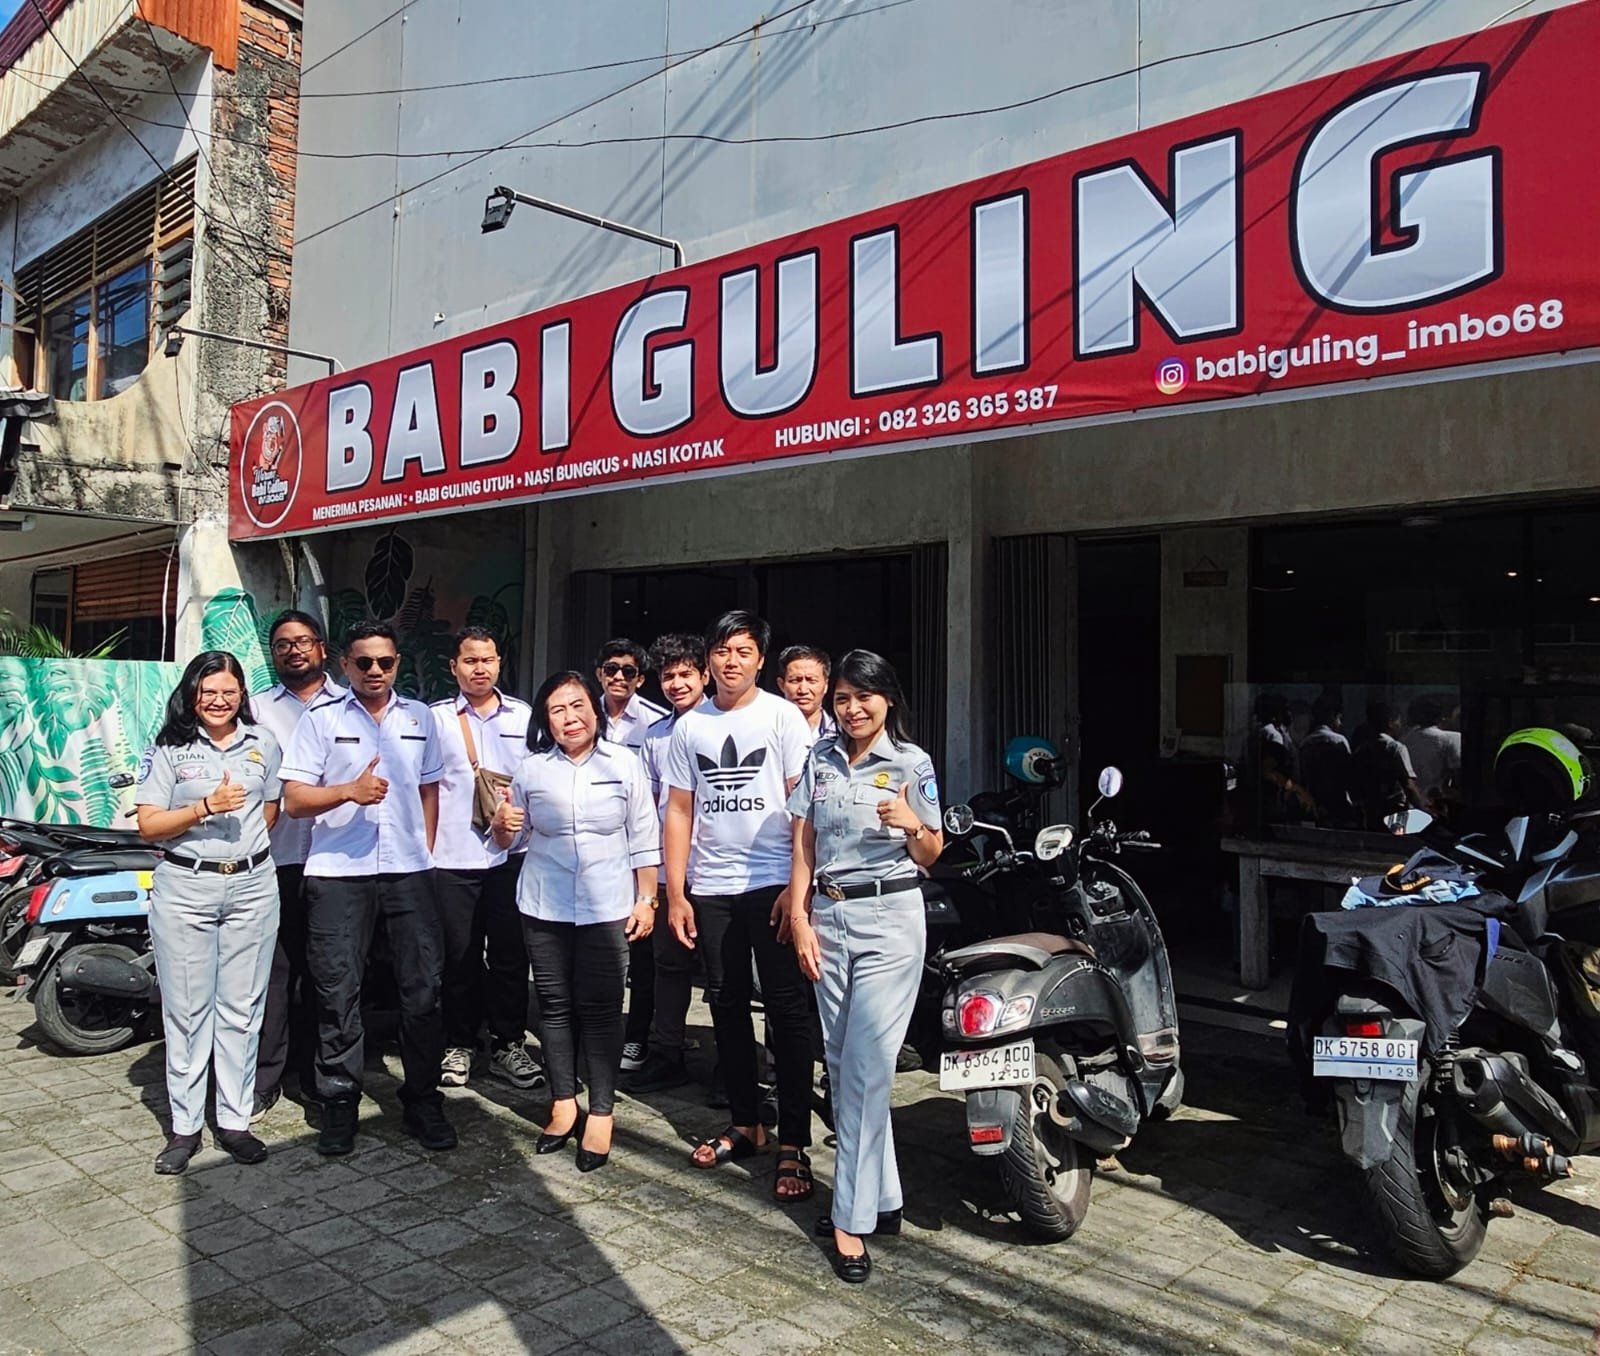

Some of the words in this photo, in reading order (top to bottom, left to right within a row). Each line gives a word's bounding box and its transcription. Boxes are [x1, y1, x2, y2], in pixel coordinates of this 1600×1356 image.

[325, 318, 573, 494] BABI
[609, 62, 1504, 440] GULING
[1196, 299, 1564, 382] babiguling_imbo68
[775, 417, 860, 448] HUBUNGI
[879, 408, 917, 432] 082
[922, 402, 961, 426] 326
[966, 392, 1009, 419] 365
[1014, 385, 1059, 412] 387
[313, 502, 358, 521] MENERIMA
[415, 487, 440, 504] BABI
[441, 482, 481, 500] GULING
[483, 474, 514, 493] UTUH
[524, 467, 554, 487] NASI
[556, 456, 620, 482] BUNGKUS
[632, 447, 667, 469] NASI
[670, 438, 725, 464] KOTAK
[177, 752, 205, 761] DIAN
[702, 794, 765, 814] adidas
[943, 1054, 960, 1071] DK
[964, 1050, 998, 1069] 6364
[1315, 1039, 1333, 1056] DK
[1339, 1041, 1379, 1058] 5758
